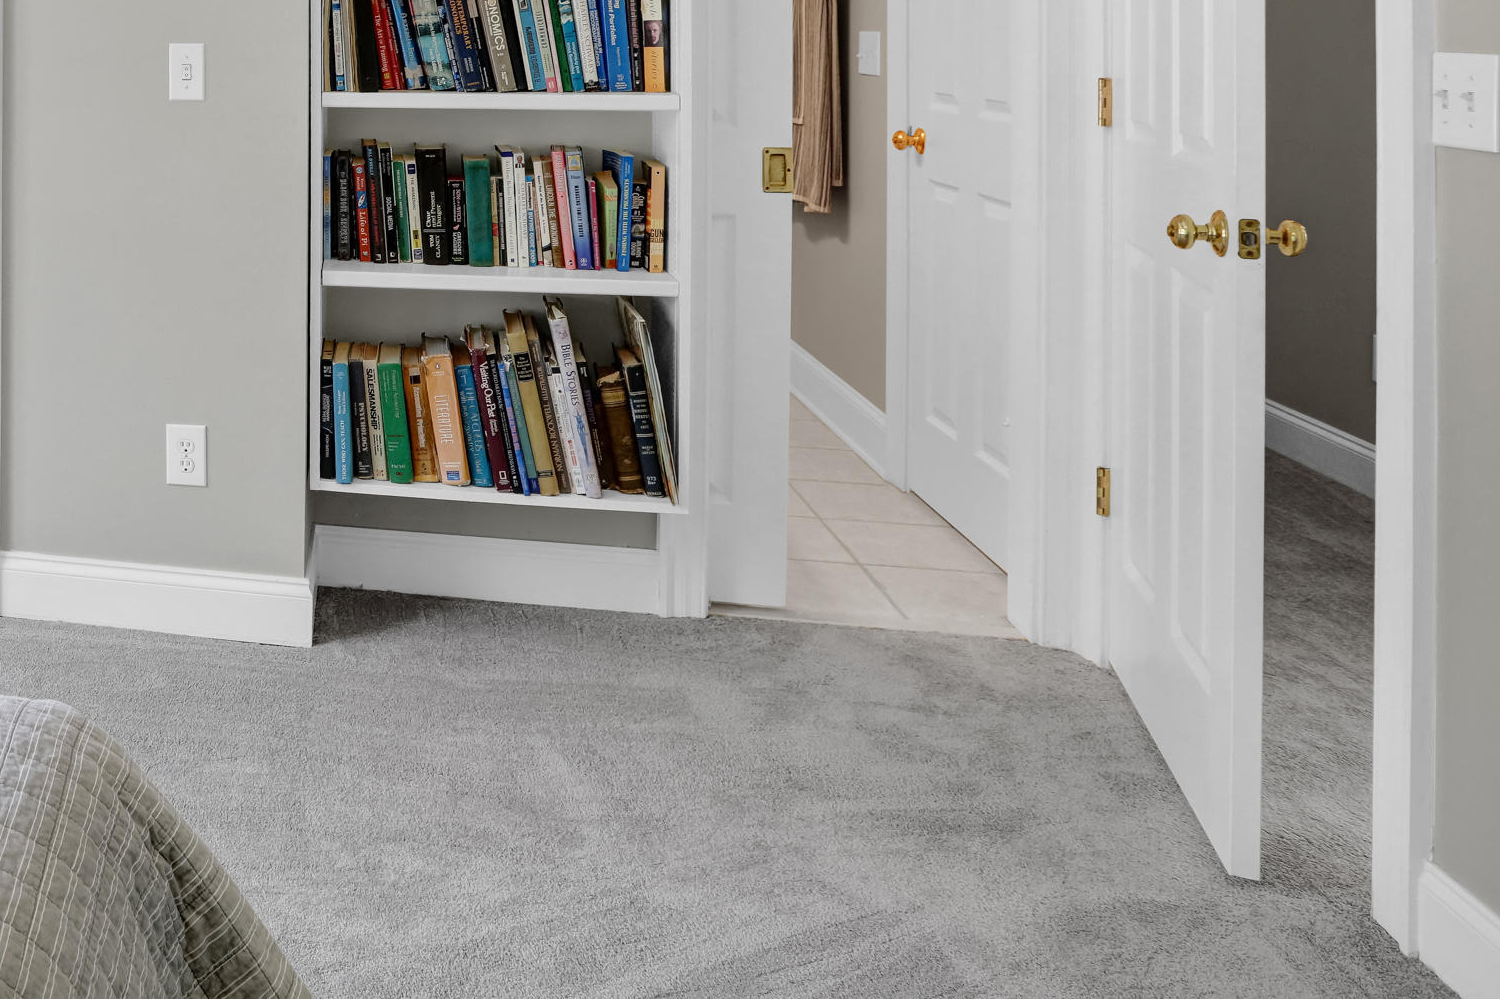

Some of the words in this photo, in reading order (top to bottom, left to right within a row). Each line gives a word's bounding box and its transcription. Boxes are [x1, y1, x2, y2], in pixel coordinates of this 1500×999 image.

[379, 46, 389, 73] Framing
[339, 179, 347, 196] BLACK
[340, 198, 348, 212] BOOK
[545, 184, 554, 207] LINCOLN
[550, 221, 558, 247] UNKNOWN
[361, 228, 367, 236] of
[362, 238, 368, 246] Pi
[560, 344, 573, 367] BIBLE
[479, 361, 490, 389] Visiting
[537, 366, 548, 401] ILLUSTRATOR
[566, 370, 580, 407] STORIES
[366, 368, 377, 430] SALESMANSHIP
[484, 388, 494, 404] Our
[434, 394, 453, 444] LITERATURE
[486, 404, 496, 418] Past
[543, 404, 556, 439] ROCKWELL
[358, 402, 368, 452] PSYCHOLOGY
[550, 440, 564, 472] NORMAN
